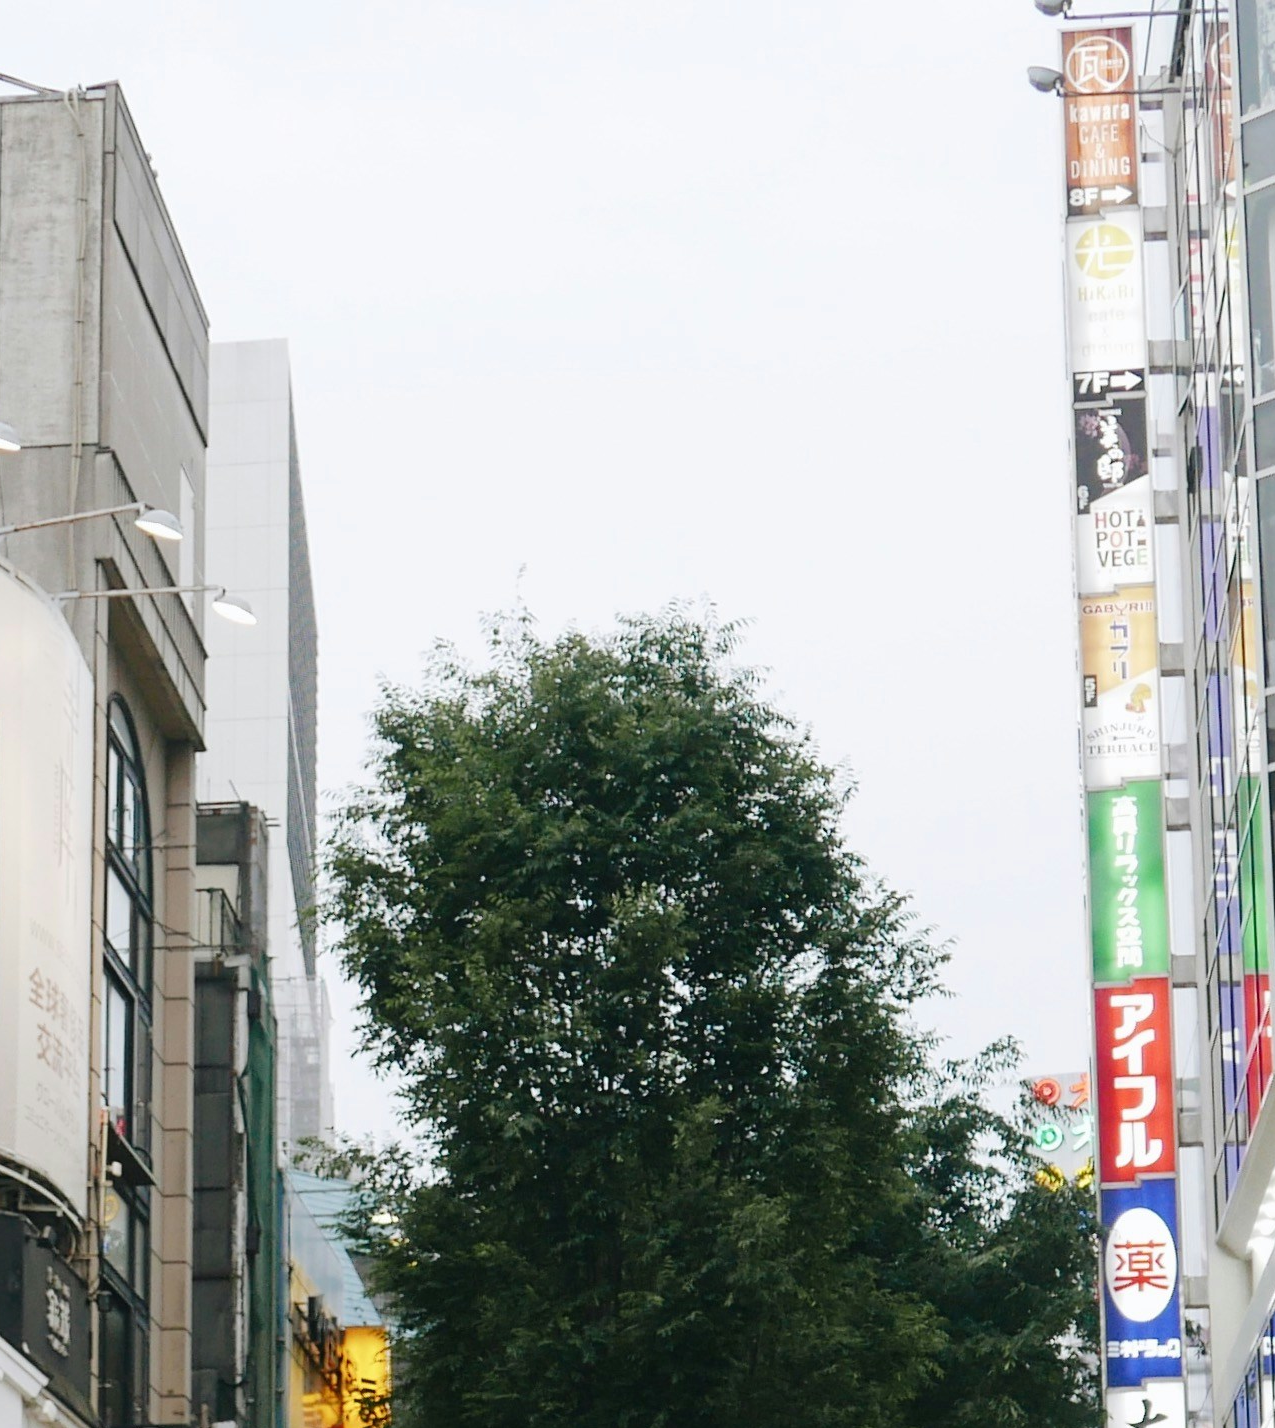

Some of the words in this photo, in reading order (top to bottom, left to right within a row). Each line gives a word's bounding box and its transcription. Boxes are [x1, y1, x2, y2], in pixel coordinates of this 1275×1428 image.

[1069, 102, 1129, 123] kawara
[1079, 124, 1119, 143] CAFE
[1071, 157, 1131, 178] DINING
[1069, 188, 1098, 206] 8F
[1075, 373, 1109, 393] 7F
[1095, 509, 1134, 529] HOT
[1097, 530, 1134, 548] POT
[1098, 549, 1148, 567] VEGE
[1085, 677, 1096, 704] 5F
[1086, 721, 1156, 741] SHINJUKU
[1087, 742, 1158, 756] TERRACE
[1110, 994, 1162, 1172] アイフル
[1113, 1240, 1170, 1292] 薬
